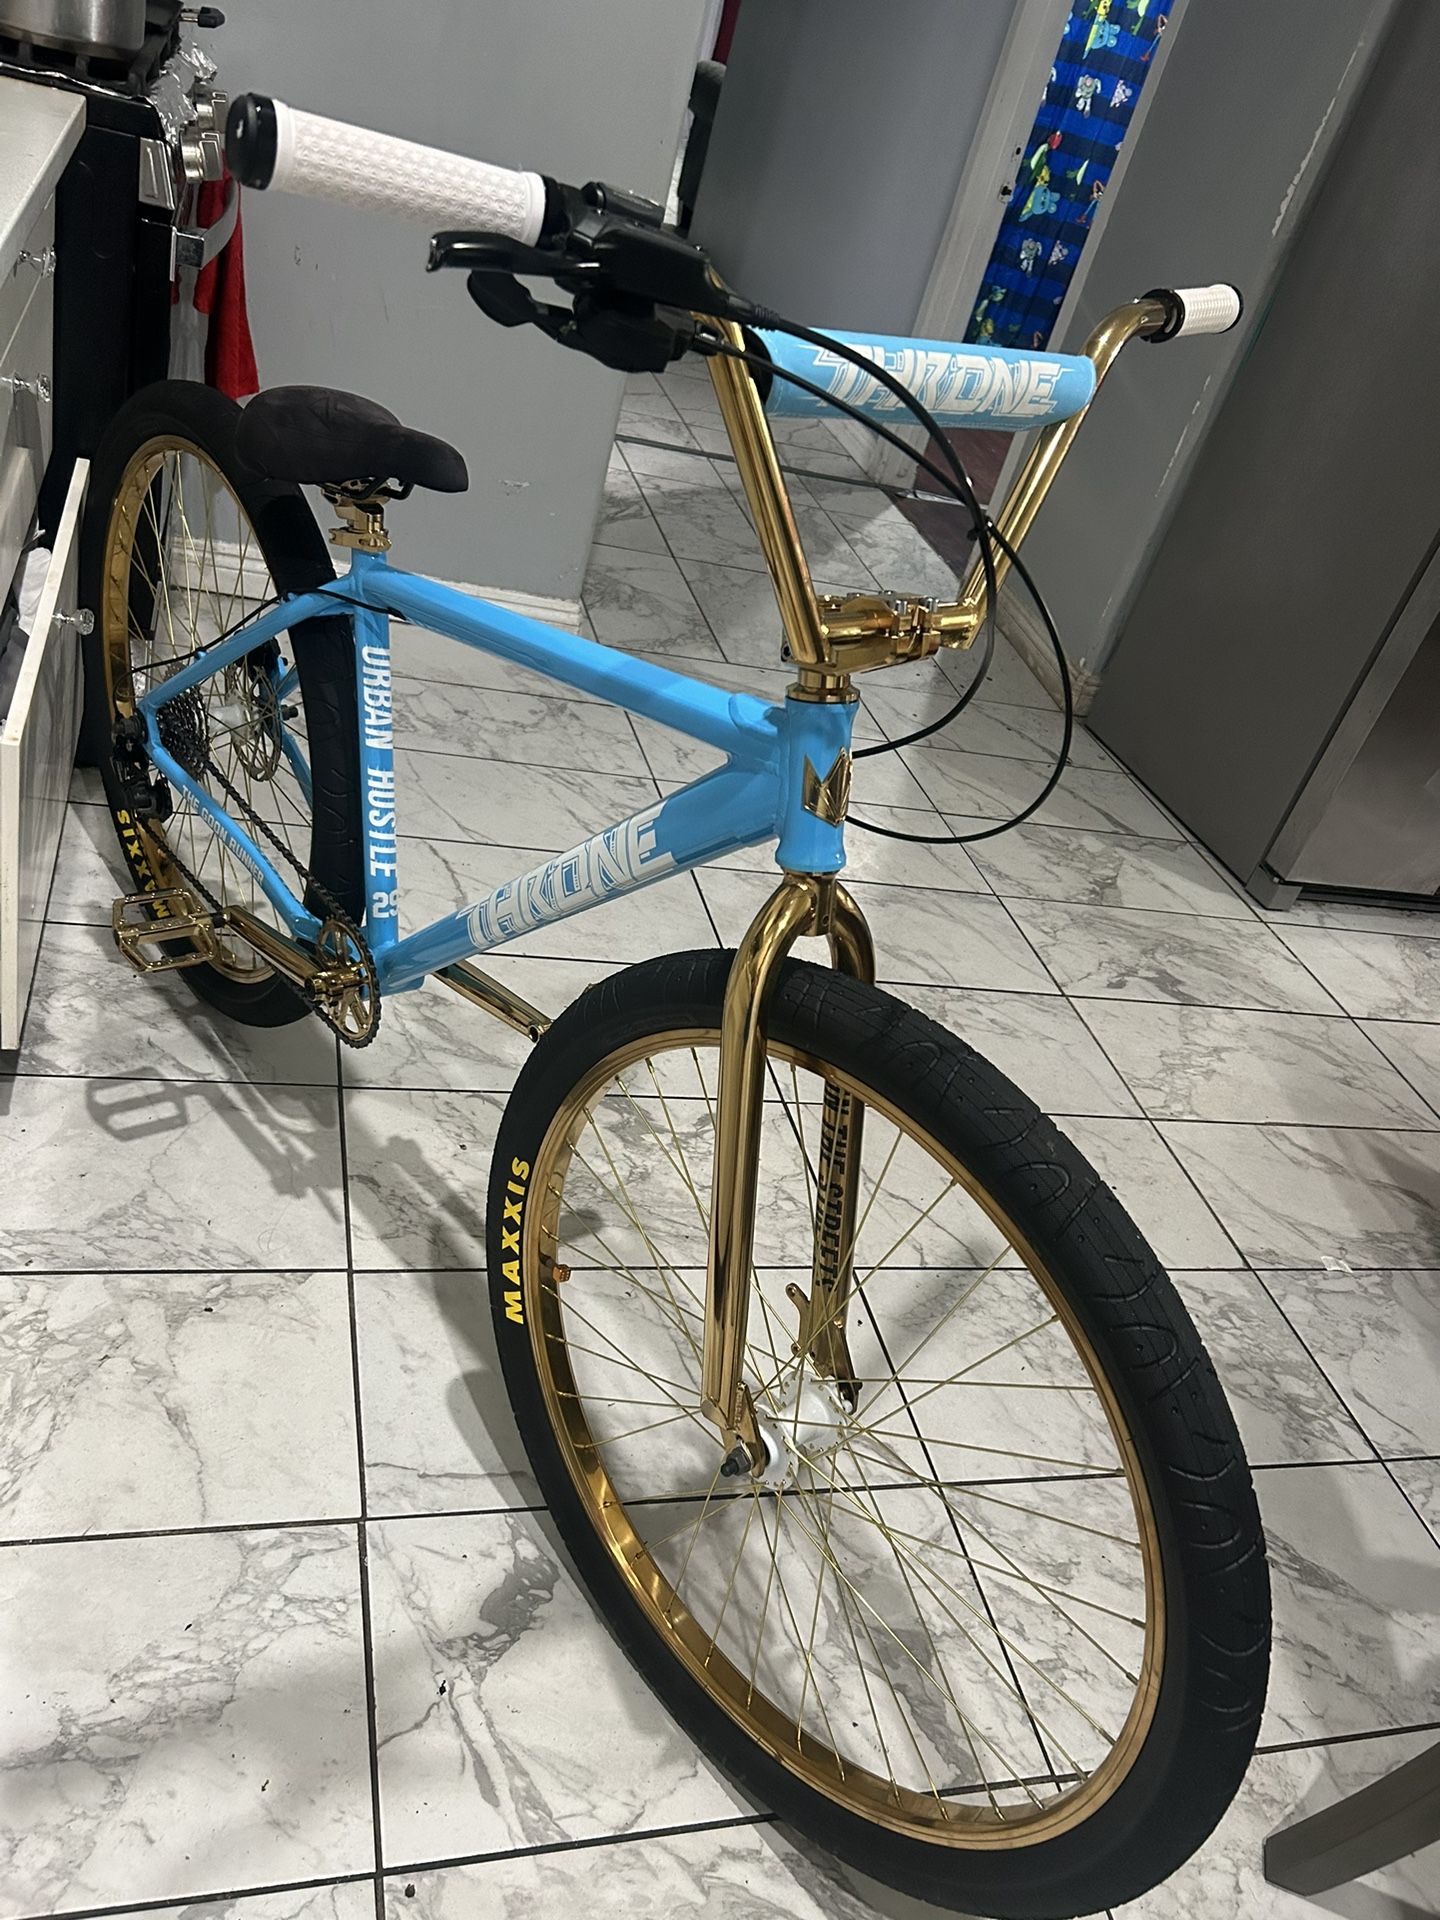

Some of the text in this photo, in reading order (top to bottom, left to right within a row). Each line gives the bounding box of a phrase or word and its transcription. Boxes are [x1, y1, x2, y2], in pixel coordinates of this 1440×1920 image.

[800, 343, 1073, 417] THRONE
[361, 645, 394, 750] URBAN
[181, 785, 264, 886] THE GOON RUNNER
[367, 765, 398, 878] HUSTLE
[456, 801, 678, 949] THRONE
[502, 1156, 530, 1325] MAXXIS
